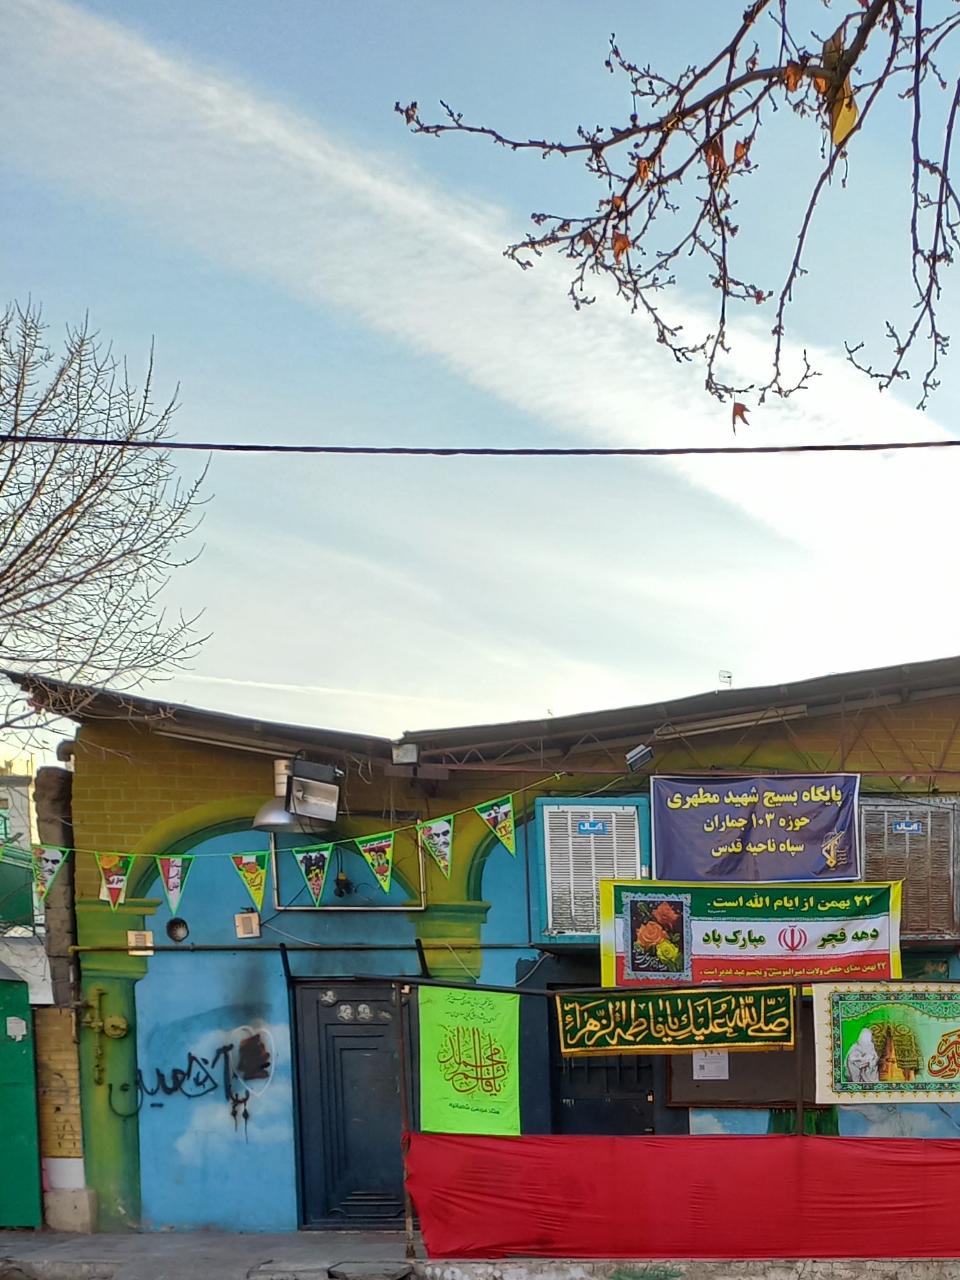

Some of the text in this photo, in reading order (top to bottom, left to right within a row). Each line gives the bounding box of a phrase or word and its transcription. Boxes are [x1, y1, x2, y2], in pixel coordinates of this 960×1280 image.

[666, 784, 843, 809] پایگاه بسیج شهید مطهری
[703, 812, 811, 832] حوزه ۱۰۳ جماران
[711, 837, 806, 858] سپاه ناحیه قدس
[749, 891, 771, 909] الله
[773, 895, 800, 911] ایام
[800, 895, 815, 912] از
[817, 896, 851, 912] بهمن
[853, 894, 874, 908] ۲۲
[702, 926, 880, 949] دهه فجر مبارک باد
[860, 963, 877, 974] بهمن
